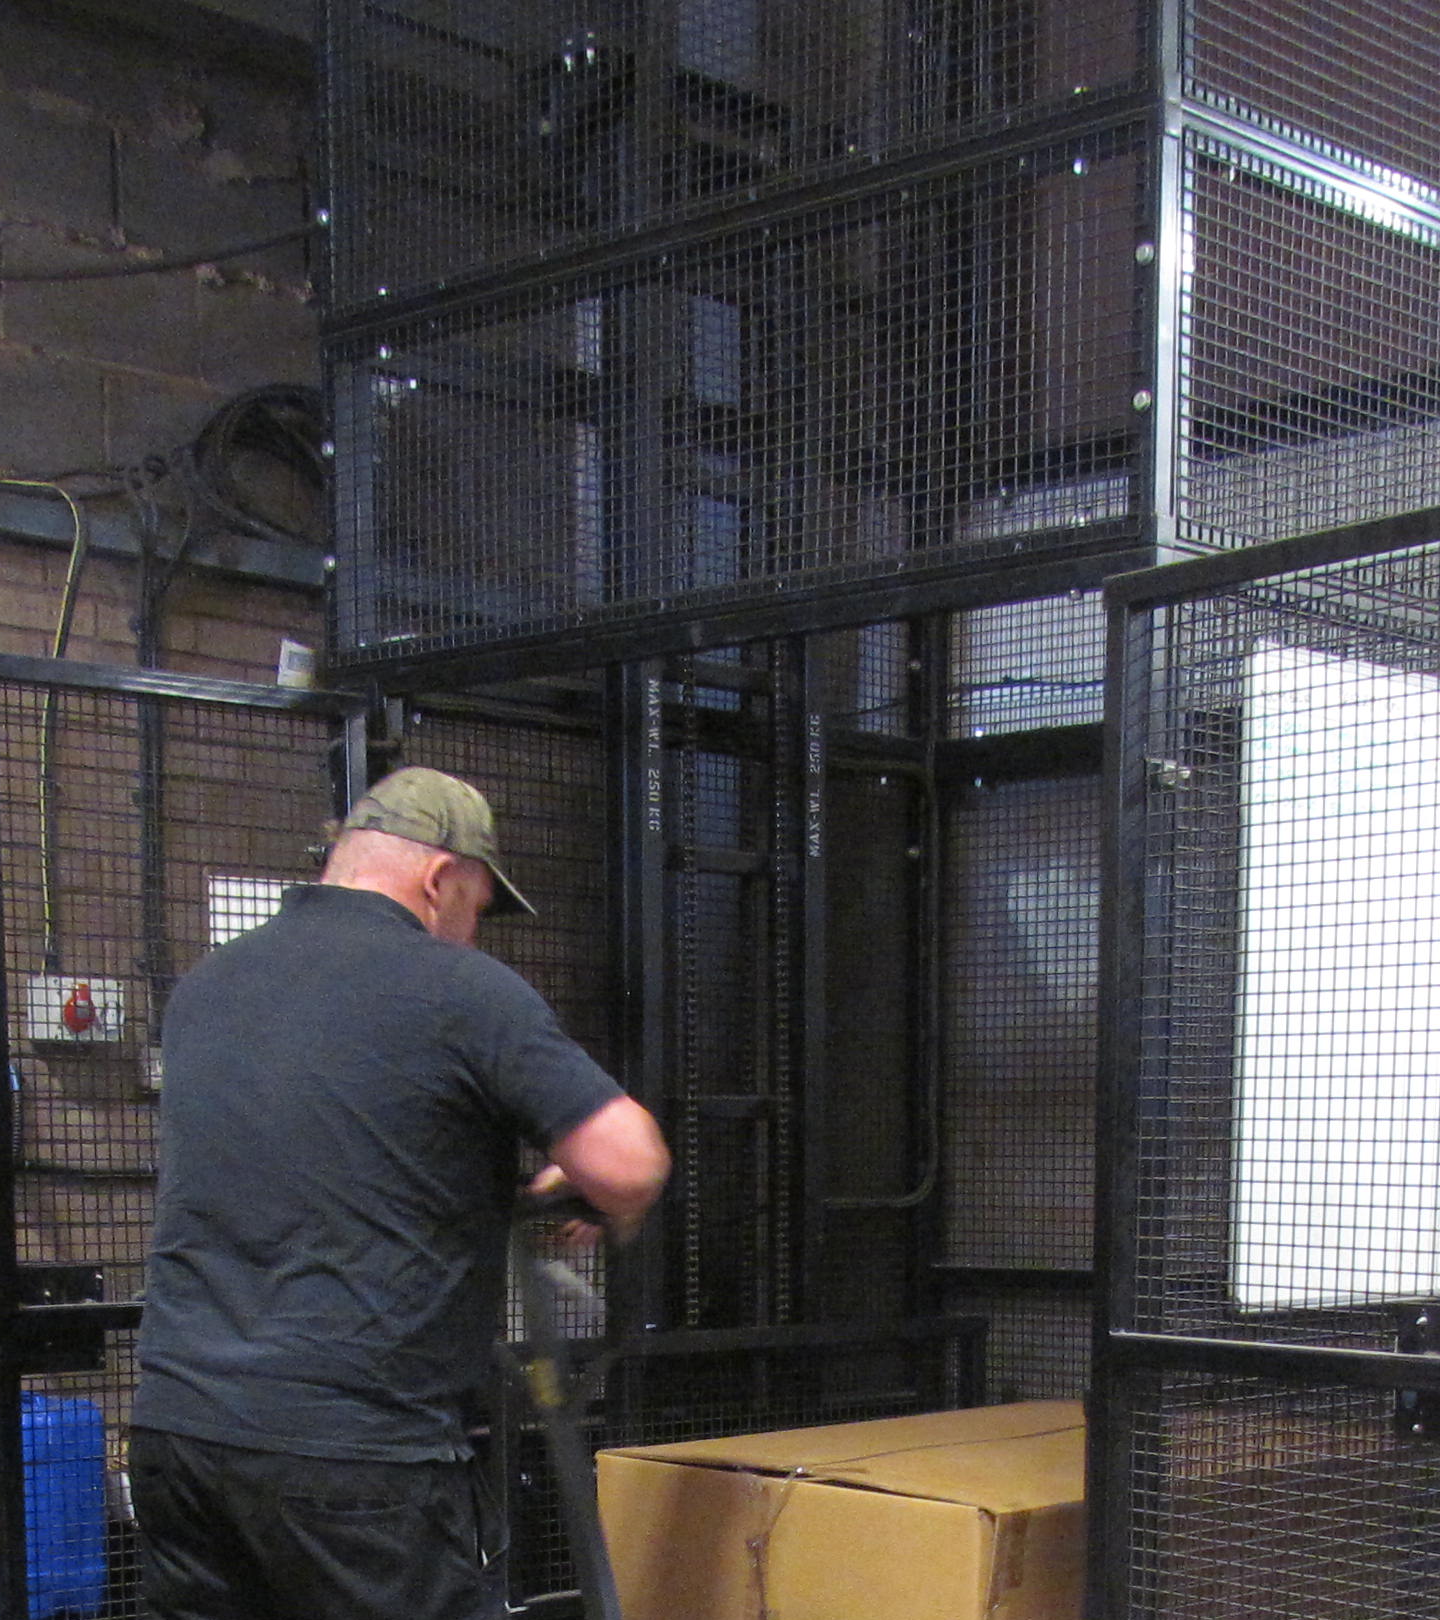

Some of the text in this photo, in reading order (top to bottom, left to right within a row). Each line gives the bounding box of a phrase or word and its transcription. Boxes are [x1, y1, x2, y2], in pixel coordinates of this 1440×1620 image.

[808, 742, 821, 775] 250
[647, 768, 660, 802] 250
[647, 807, 661, 831] KG
